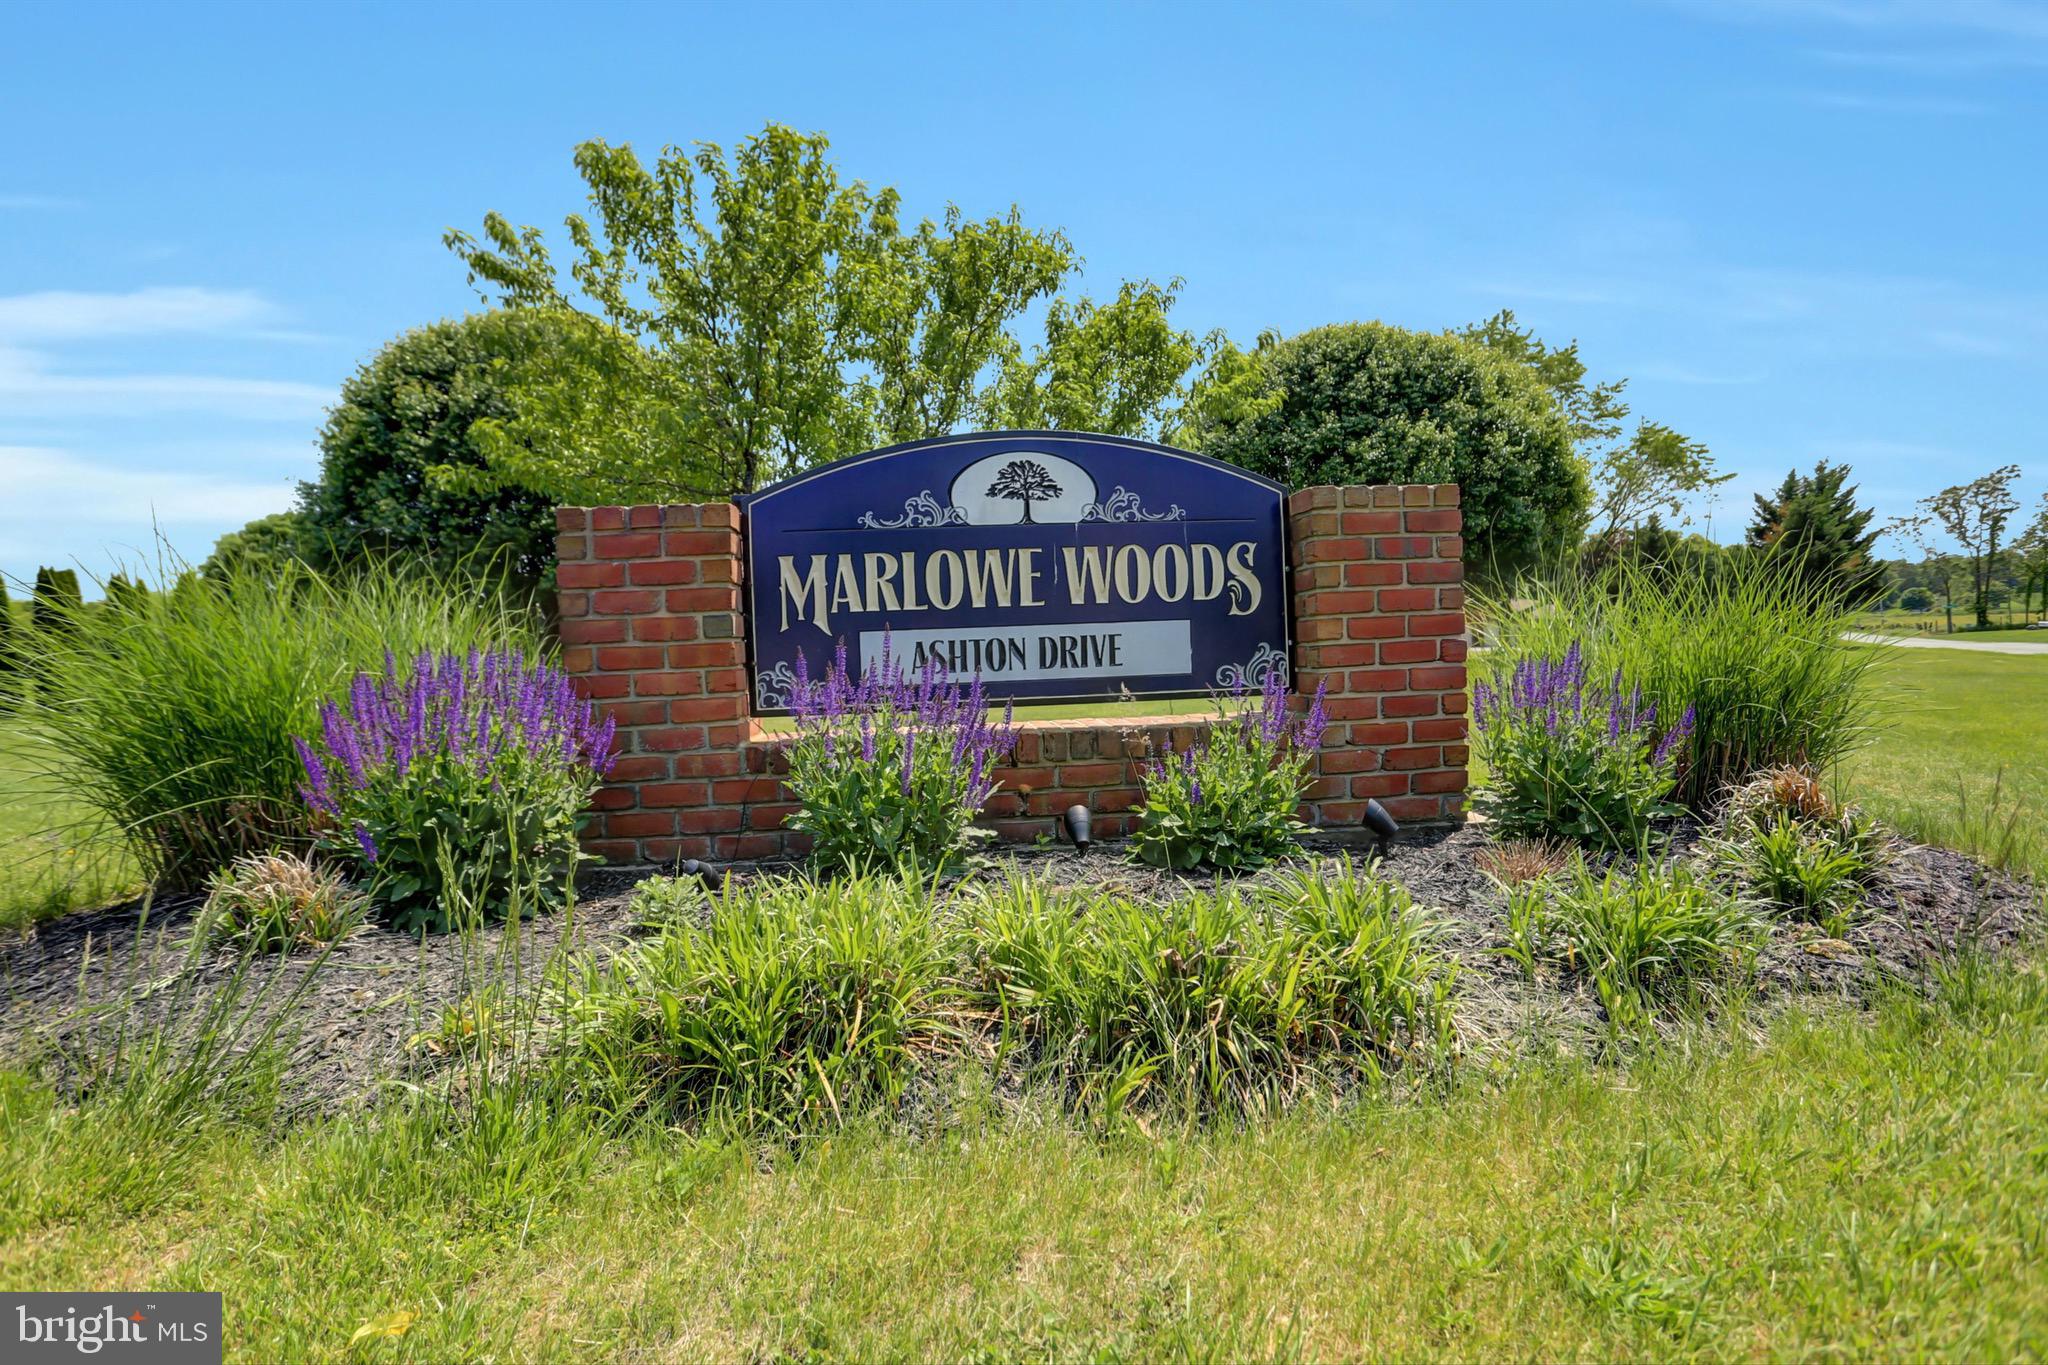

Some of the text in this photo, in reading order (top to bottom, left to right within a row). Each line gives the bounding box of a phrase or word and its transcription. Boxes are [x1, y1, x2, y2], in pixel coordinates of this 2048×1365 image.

[777, 541, 1262, 636] MARLOWE WOODS
[912, 633, 1123, 675] ASHTON DRIVE
